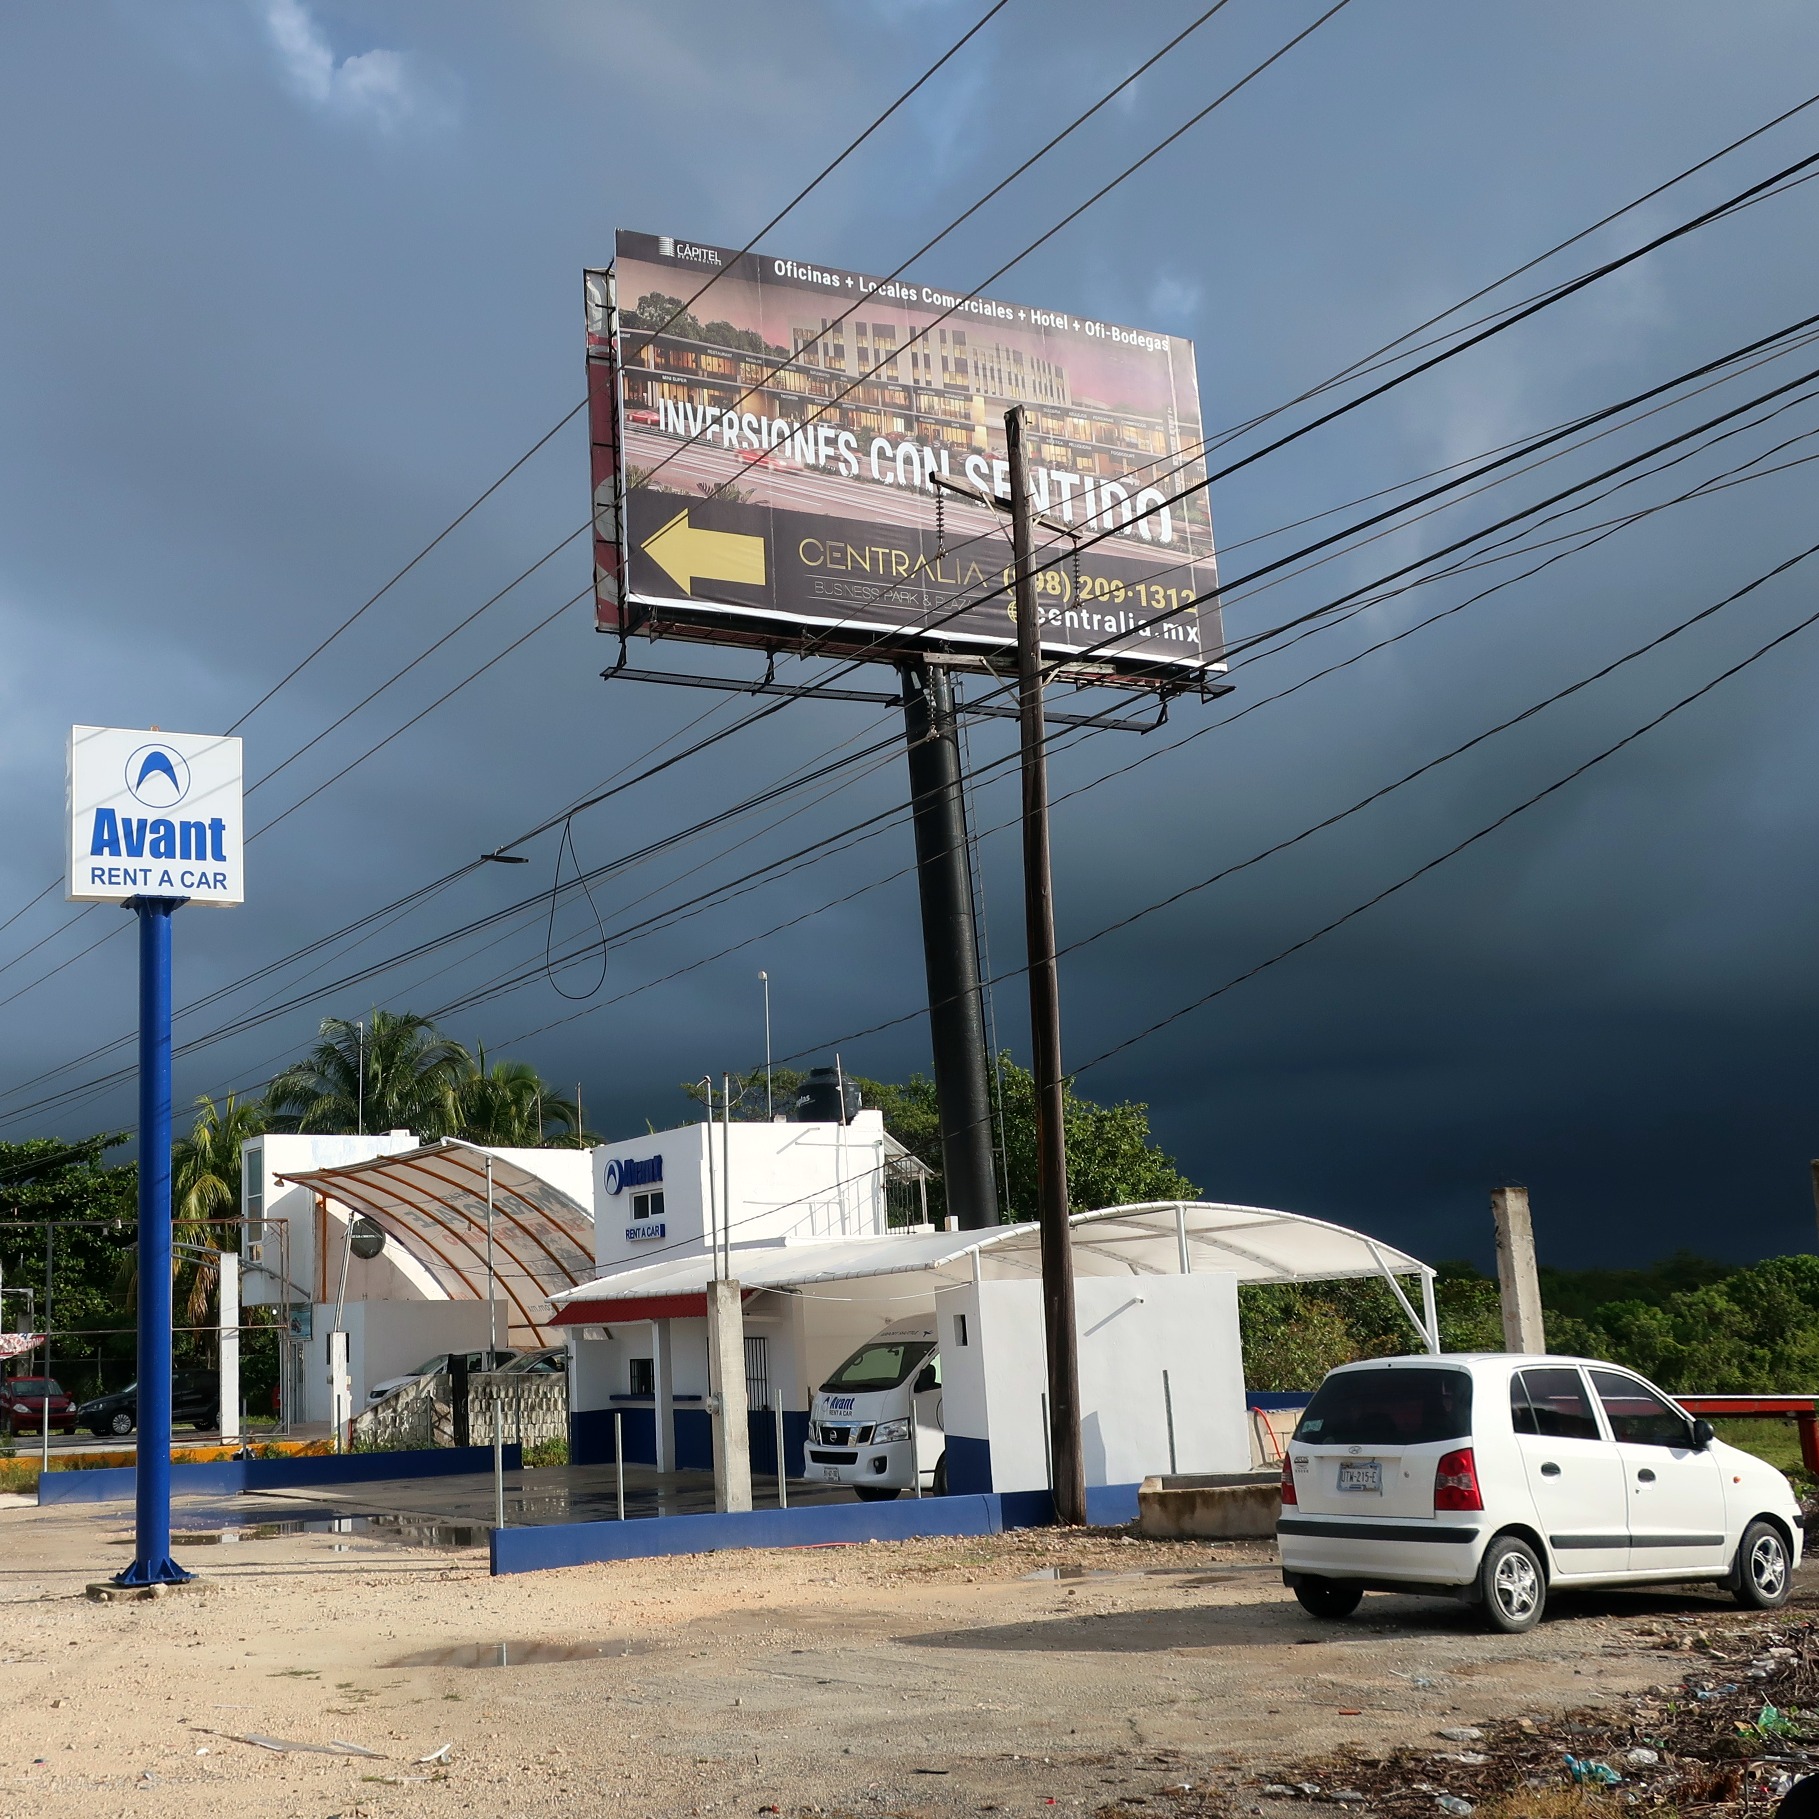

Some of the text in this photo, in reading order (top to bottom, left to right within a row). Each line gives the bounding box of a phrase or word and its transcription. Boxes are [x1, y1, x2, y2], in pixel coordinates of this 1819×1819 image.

[774, 260, 1169, 352] Oficinas + Locales Comerciales + Hotel + Ofi-Bodegas
[659, 398, 1173, 543] INVERSIONES CON SENTIDO
[799, 538, 988, 588] CENTRALIA
[884, 589, 919, 605] PARK
[923, 595, 932, 607] &
[90, 808, 227, 862] Avant
[91, 867, 228, 890] RENT A CAR
[626, 1225, 660, 1240] RENT A CAR
[830, 1396, 855, 1410] Avant
